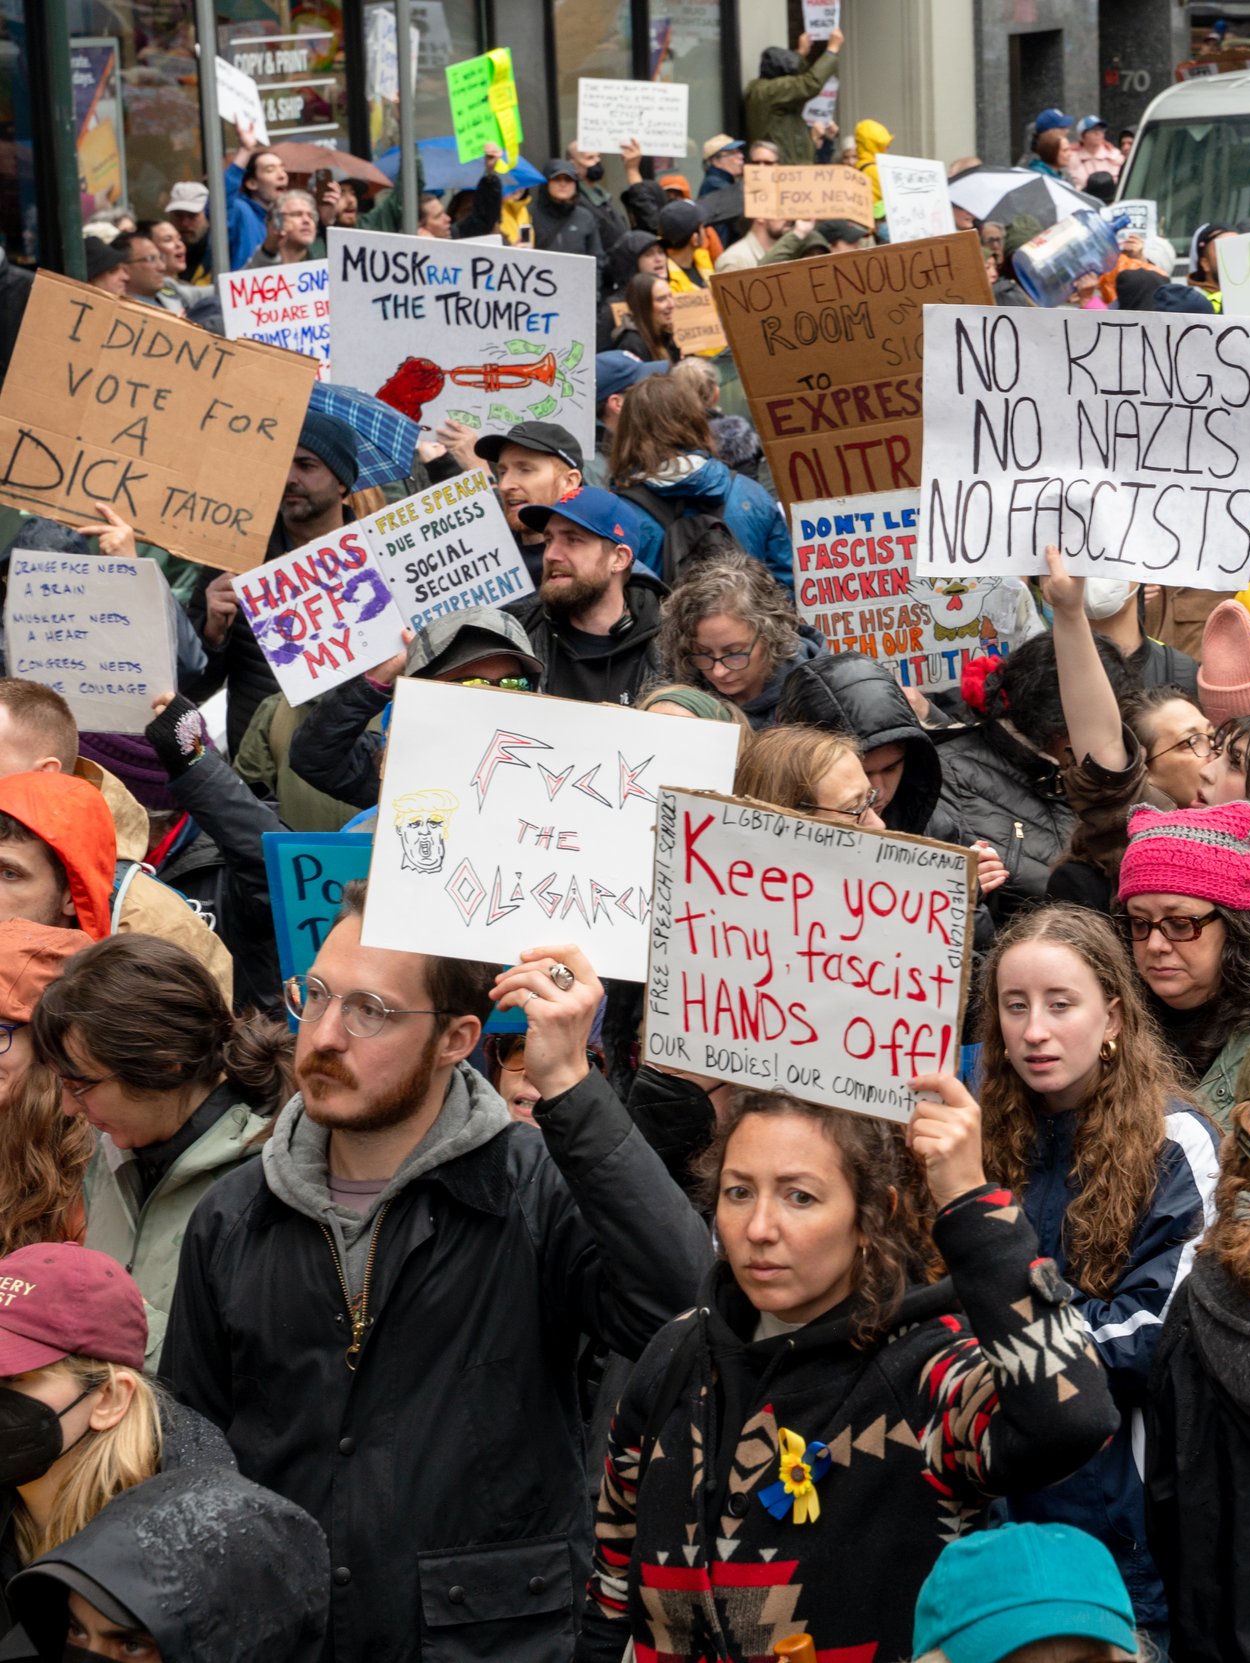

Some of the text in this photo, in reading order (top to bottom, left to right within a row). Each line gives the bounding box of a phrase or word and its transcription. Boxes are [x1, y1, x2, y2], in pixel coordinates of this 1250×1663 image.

[276, 50, 308, 73] PRINT
[1120, 70, 1151, 92] 70
[278, 96, 304, 120] SHIP
[751, 170, 867, 186] I LOST MY DAD
[780, 190, 814, 206] FOX
[342, 245, 558, 296] MUSKRAT PLAYS
[720, 272, 792, 317] NOT
[808, 246, 955, 305] ENOUGH
[68, 300, 94, 342] I
[372, 291, 560, 334] THE TRUMPET
[760, 301, 876, 356] ROOM
[956, 314, 1020, 395] NO
[67, 362, 279, 442] VOTE FOR
[798, 372, 832, 391] TO
[110, 416, 149, 457] A
[974, 396, 1240, 479] NO NAZIS
[160, 486, 255, 536] TATOR
[375, 470, 488, 536] FREE SPEACH
[800, 508, 920, 541] DON'T LE
[928, 477, 993, 564] NO
[386, 501, 486, 558] DUE PROCESS
[60, 562, 91, 575] FACE
[98, 563, 138, 576] NEEDS
[405, 538, 475, 585] SOCIAL
[796, 534, 918, 572] FASCIST
[24, 582, 86, 597] A BRAIN
[240, 534, 368, 617] HANDS
[414, 547, 502, 603] SECURITY
[800, 566, 910, 607] CHICKEN
[12, 612, 131, 626] MUSKRAT NEEDS
[275, 582, 346, 643] OFF
[858, 608, 895, 634] HIS
[898, 604, 932, 629] ASS
[27, 630, 89, 642] A HEART
[302, 627, 356, 680] MY
[882, 626, 924, 657] OUR
[17, 658, 144, 674] CONGRESS NEEDS
[79, 682, 148, 696] COURAGE
[516, 818, 582, 852] THE
[683, 810, 815, 936] Keep
[796, 922, 954, 1009] fascist
[652, 963, 670, 1016] FREE
[682, 970, 818, 1046] HANDS
[649, 1032, 691, 1062] OUR
[786, 1066, 826, 1092] OUR
